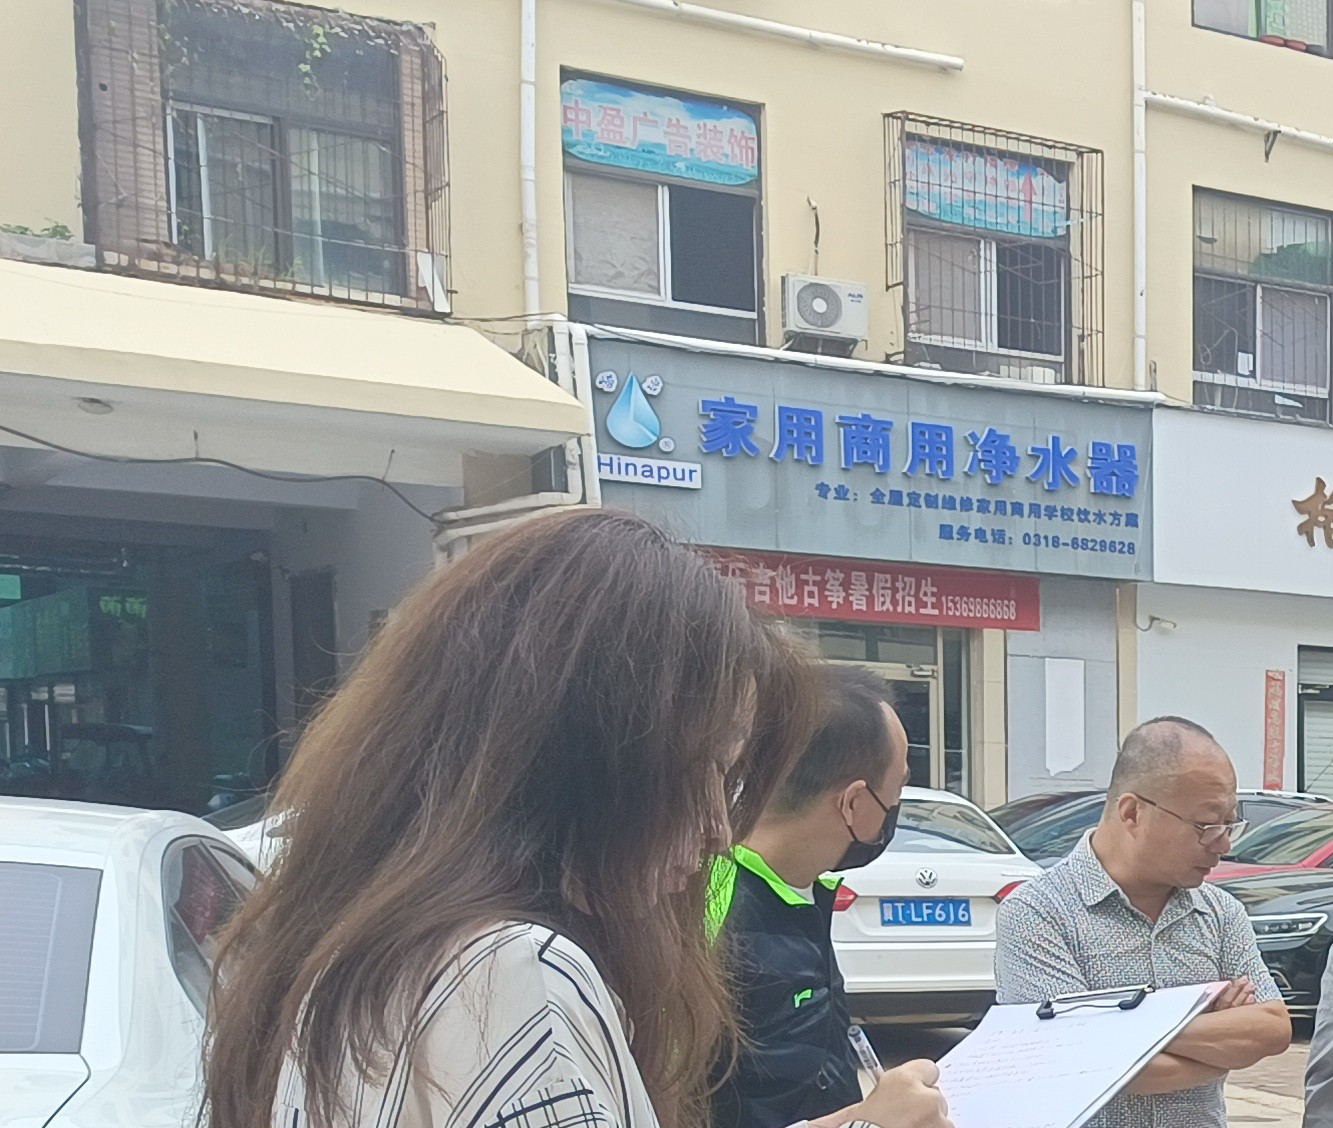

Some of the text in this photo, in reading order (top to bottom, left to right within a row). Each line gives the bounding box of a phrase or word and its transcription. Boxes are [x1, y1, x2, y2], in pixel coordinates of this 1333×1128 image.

[562, 98, 757, 168] 中盈广告装饰
[596, 455, 698, 483] Hinapur
[699, 395, 1139, 498] 家用商用净水器
